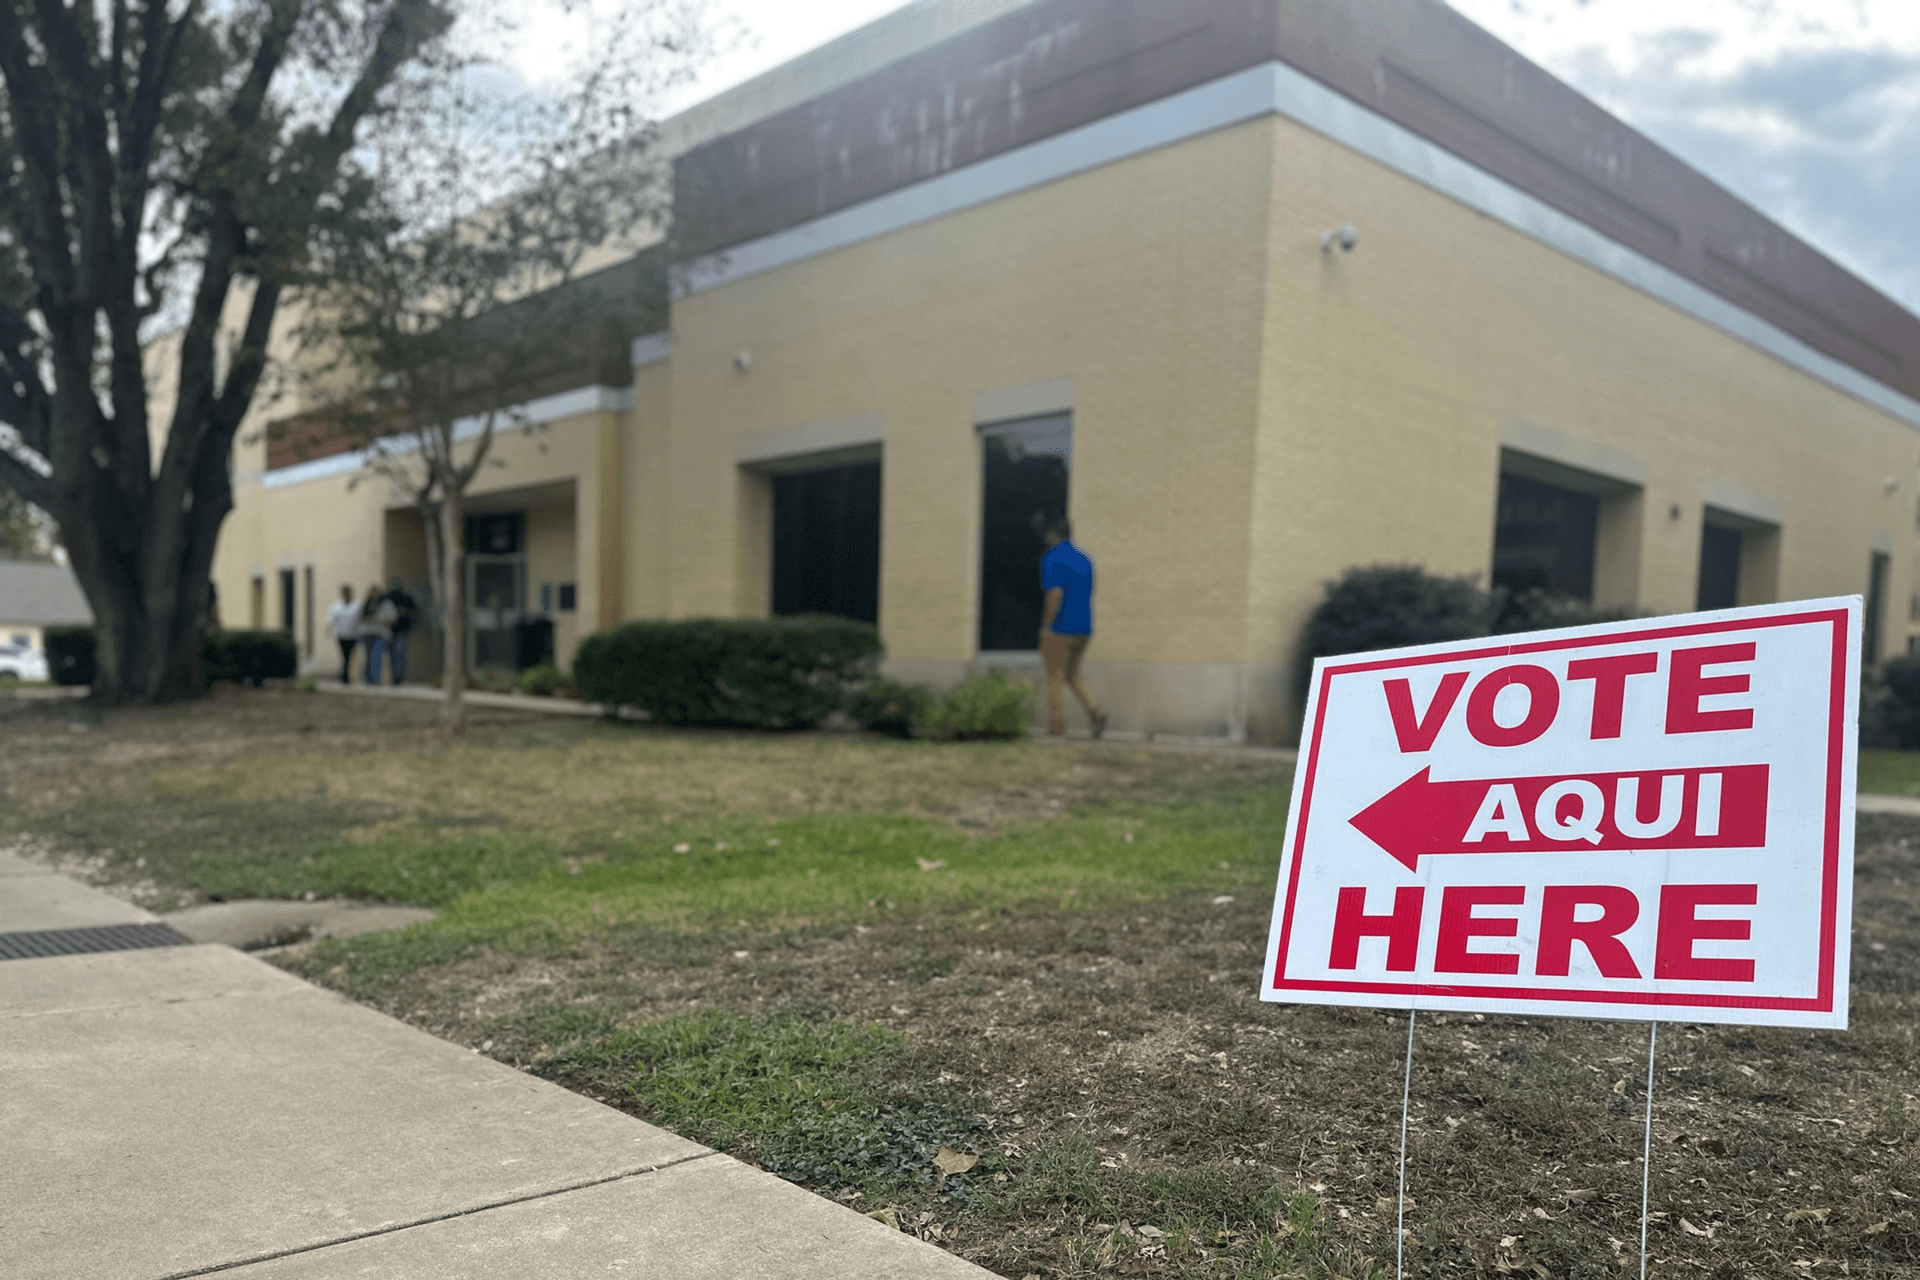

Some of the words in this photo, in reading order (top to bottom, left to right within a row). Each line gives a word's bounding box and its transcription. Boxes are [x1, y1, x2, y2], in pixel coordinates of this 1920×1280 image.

[1383, 642, 1756, 753] VOTE
[1462, 772, 1723, 846] AQUI
[1328, 884, 1758, 982] HERE
